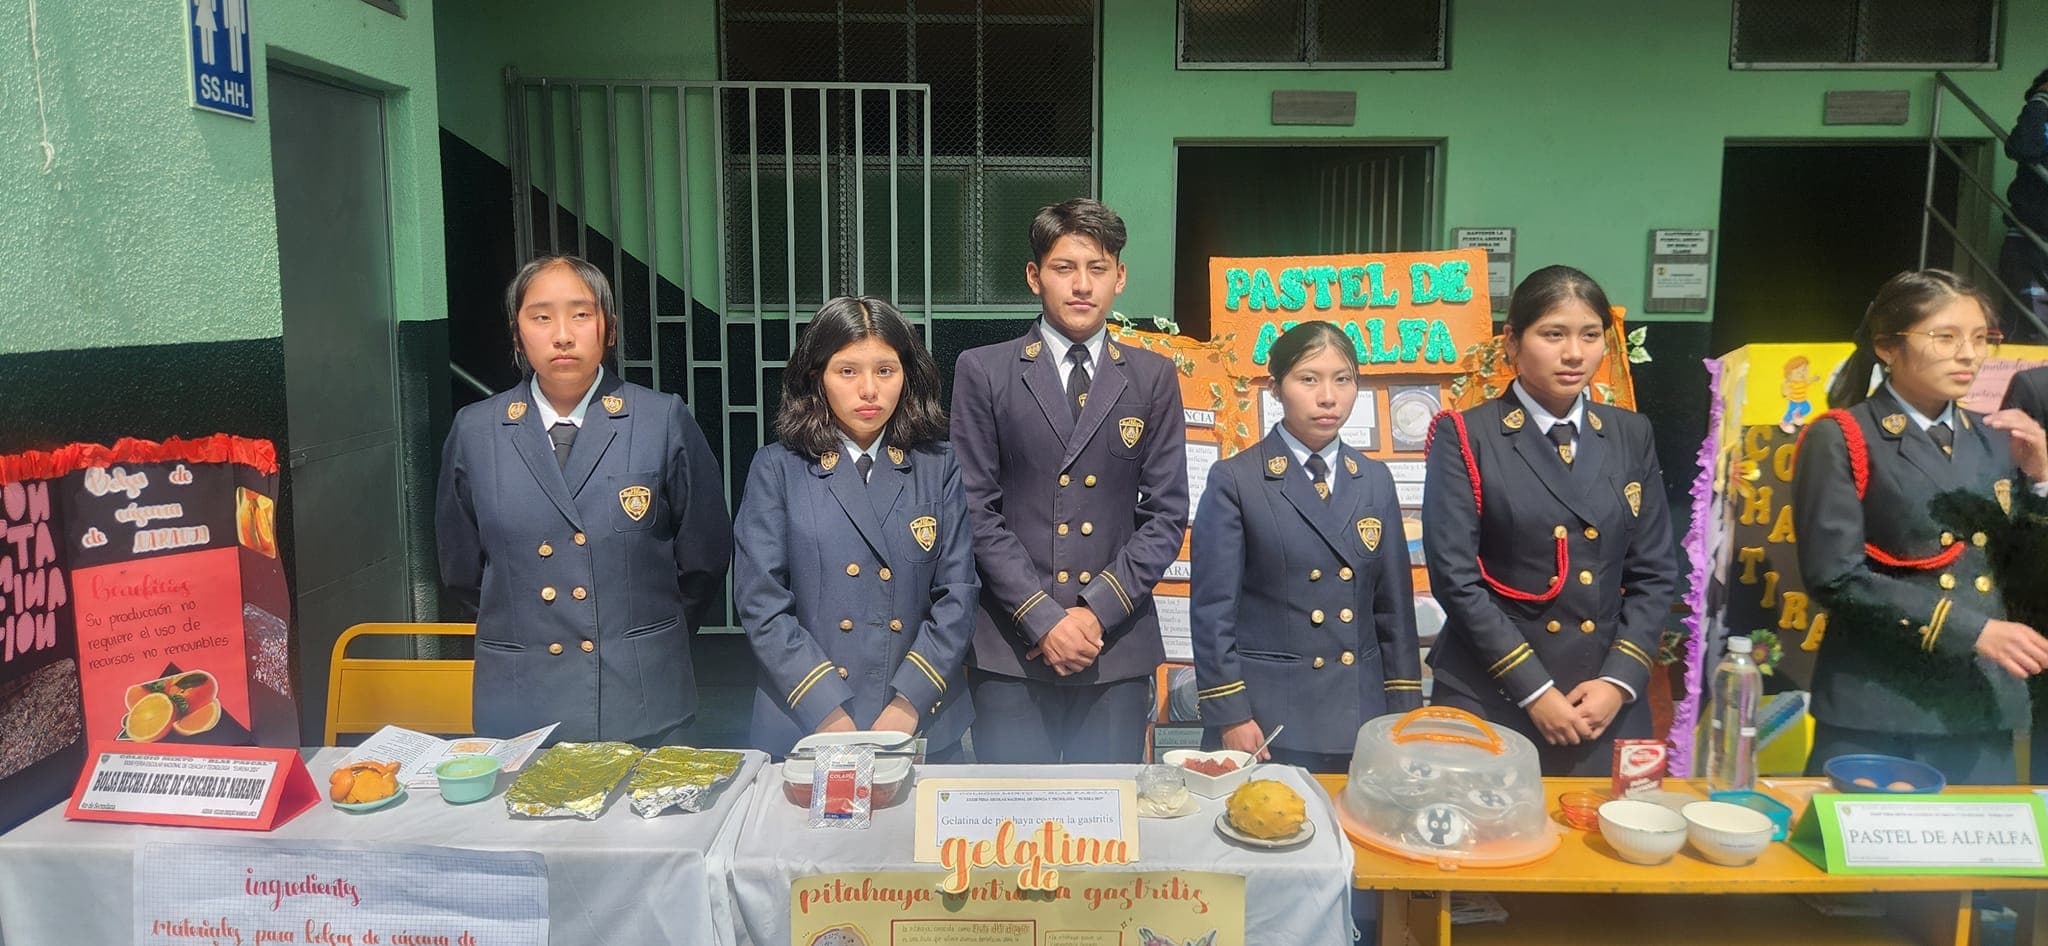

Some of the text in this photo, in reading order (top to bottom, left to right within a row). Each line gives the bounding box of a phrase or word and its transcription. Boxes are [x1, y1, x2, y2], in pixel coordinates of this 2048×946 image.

[200, 73, 249, 108] SS.HH.
[1225, 262, 1399, 310] PASTEL
[1410, 260, 1473, 304] DE
[1252, 318, 1458, 365] AALFA
[1185, 411, 1212, 422] NCIA
[169, 464, 193, 484] de
[0, 481, 50, 530] ON
[82, 527, 108, 548] de
[85, 600, 196, 630] Su producción no
[0, 608, 56, 662] ION
[88, 617, 201, 651] requiere el uso de
[89, 636, 229, 670] recursos no renovables
[93, 771, 121, 792] BOLSA
[116, 771, 148, 794] HECHA
[149, 774, 174, 795] BASE
[168, 774, 186, 796] DE
[215, 777, 232, 798] DE
[941, 815, 979, 826] Gelatina
[982, 814, 993, 826] de
[1067, 813, 1075, 825] la
[1078, 813, 1114, 828] gastritis
[1850, 829, 2034, 846] PASTEL DE ALFALFA
[940, 820, 1128, 894] gelatina
[1018, 855, 1058, 891] de
[245, 867, 362, 912] ingredientes
[800, 877, 933, 914] pitahaya
[1084, 876, 1208, 914] gastritis
[255, 929, 294, 946] para
[362, 929, 379, 945] de
[457, 930, 476, 946] de
